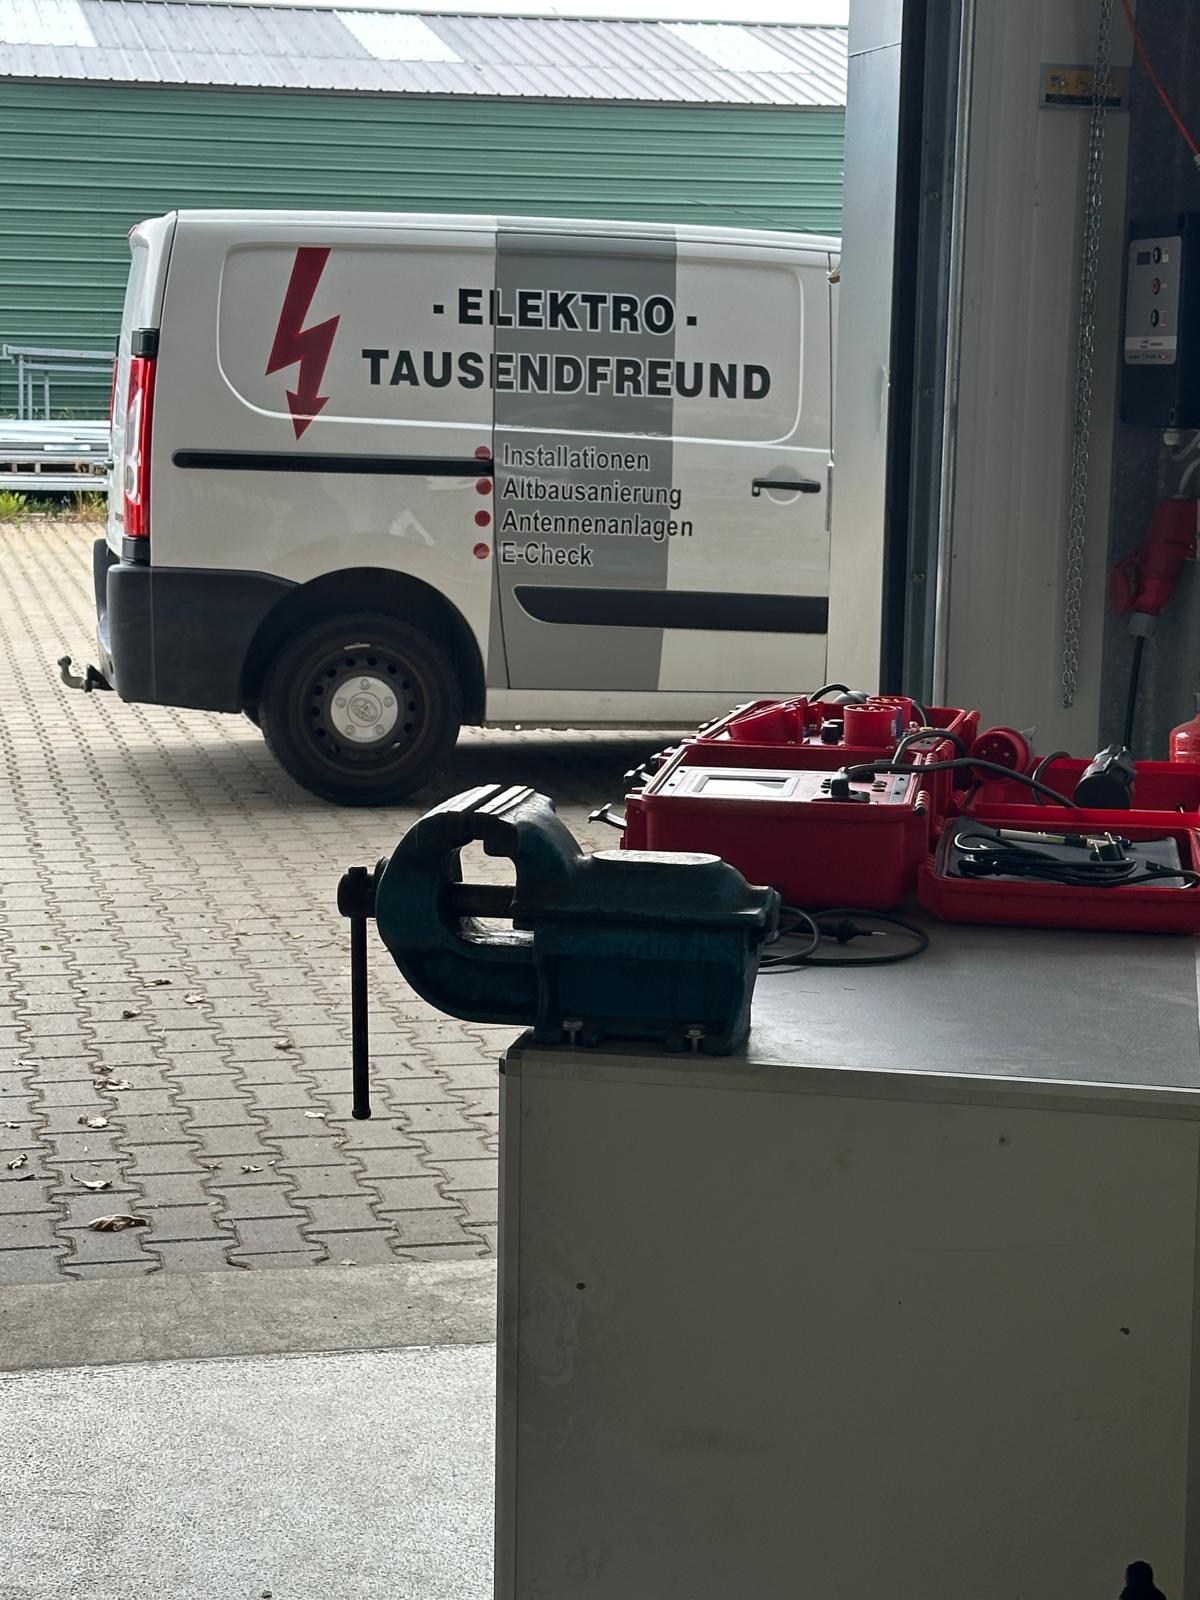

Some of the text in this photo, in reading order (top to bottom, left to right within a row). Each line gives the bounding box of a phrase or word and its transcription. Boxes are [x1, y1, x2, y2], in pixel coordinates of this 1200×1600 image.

[458, 288, 676, 334] ELEKTRO
[361, 348, 771, 400] TAUSENDFREUND
[502, 443, 651, 472] Installationen
[502, 476, 683, 510] Altbausanierung
[501, 509, 694, 543] Antennenanlagen
[501, 541, 594, 568] E-Check
